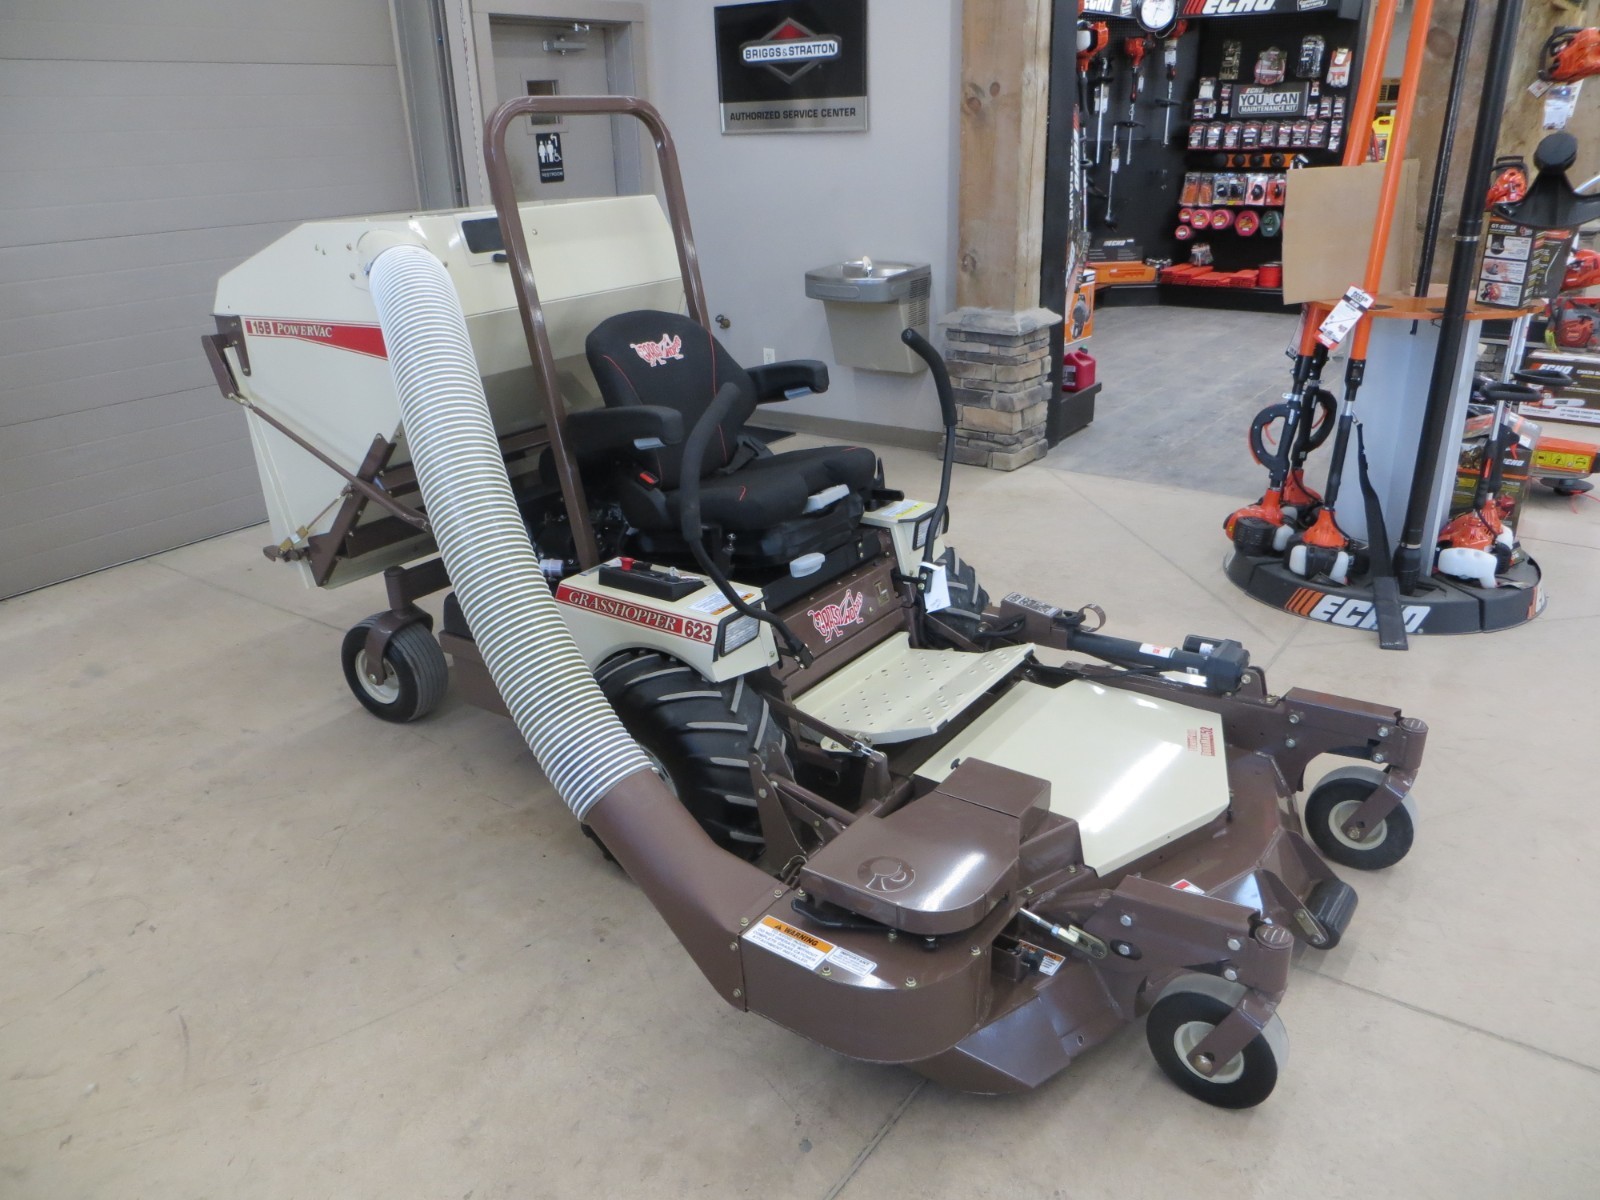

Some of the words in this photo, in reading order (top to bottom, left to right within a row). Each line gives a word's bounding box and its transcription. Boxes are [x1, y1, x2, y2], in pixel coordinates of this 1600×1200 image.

[1202, 0, 1276, 15] ECHO
[745, 48, 782, 60] BRIGGS
[788, 43, 836, 56] STRATTON
[1241, 95, 1264, 105] YOU
[1273, 93, 1297, 104] CAN
[730, 110, 781, 121] AUTHORIZED
[782, 108, 819, 118] SERVICE
[820, 107, 856, 117] CENTER
[568, 591, 675, 631] GRASSHOPPER
[685, 620, 713, 642] 623
[782, 927, 819, 946] WARNING
